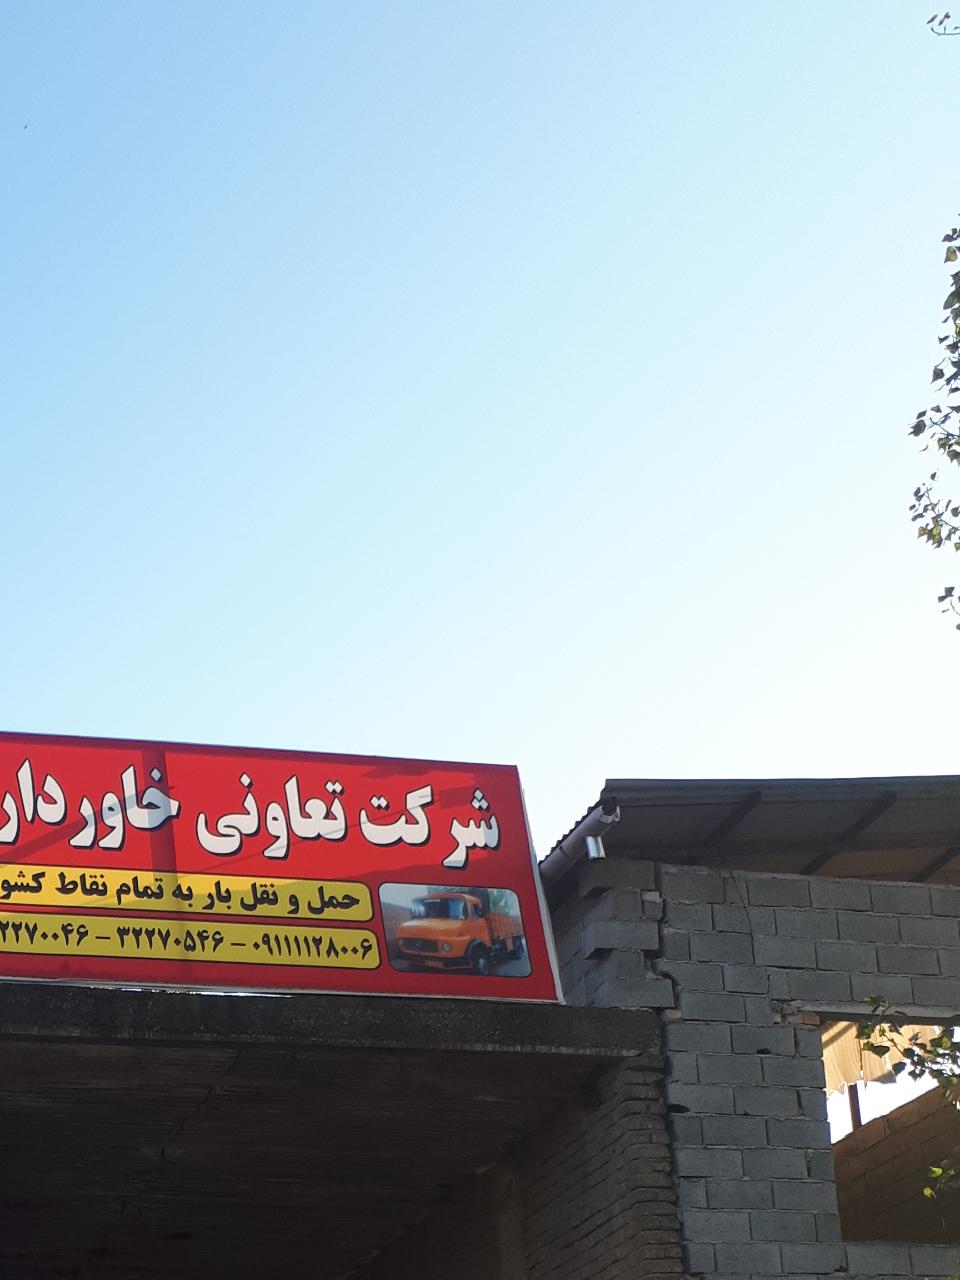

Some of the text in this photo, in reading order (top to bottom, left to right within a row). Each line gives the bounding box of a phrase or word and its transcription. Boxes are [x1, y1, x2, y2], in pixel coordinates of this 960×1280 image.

[196, 772, 347, 859] تعاونی
[359, 784, 499, 868] شرکت
[55, 871, 108, 897] نقاط
[116, 875, 164, 906] تمام
[171, 883, 194, 908] به
[202, 880, 232, 910] بار
[240, 882, 279, 911] نقل
[287, 894, 300, 914] و
[307, 885, 360, 915] حمل
[116, 925, 224, 953] ۳۲۲۷۰۵۴۶
[252, 932, 373, 961] ۰۹۱۱۱۱۲۸۰۰۶
